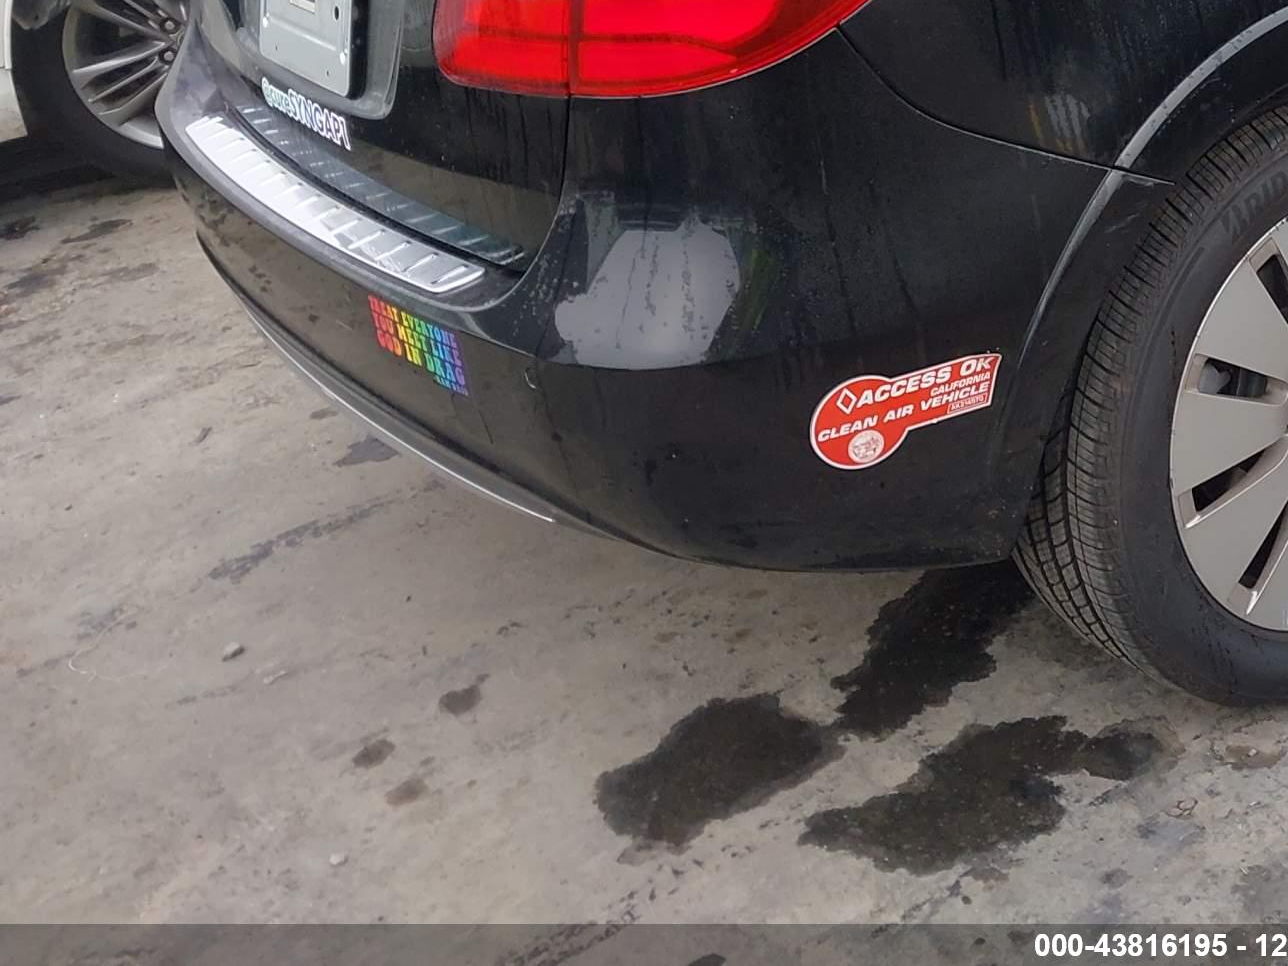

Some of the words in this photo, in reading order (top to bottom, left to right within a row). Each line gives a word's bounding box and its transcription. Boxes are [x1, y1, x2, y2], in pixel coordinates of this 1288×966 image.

[372, 312, 394, 336] YOU
[396, 323, 428, 352] MEET
[430, 339, 463, 367] LIKE
[400, 311, 457, 348] EVERYONE
[376, 328, 402, 357] GOD
[404, 343, 423, 367] IN
[424, 352, 466, 385] DRAG
[856, 365, 953, 409] ACCESS
[960, 357, 995, 377] OK
[930, 372, 991, 397] CALIFORNIA
[817, 414, 878, 443] CLEAN
[883, 404, 915, 423] AIR
[920, 381, 990, 411] VEHICLE
